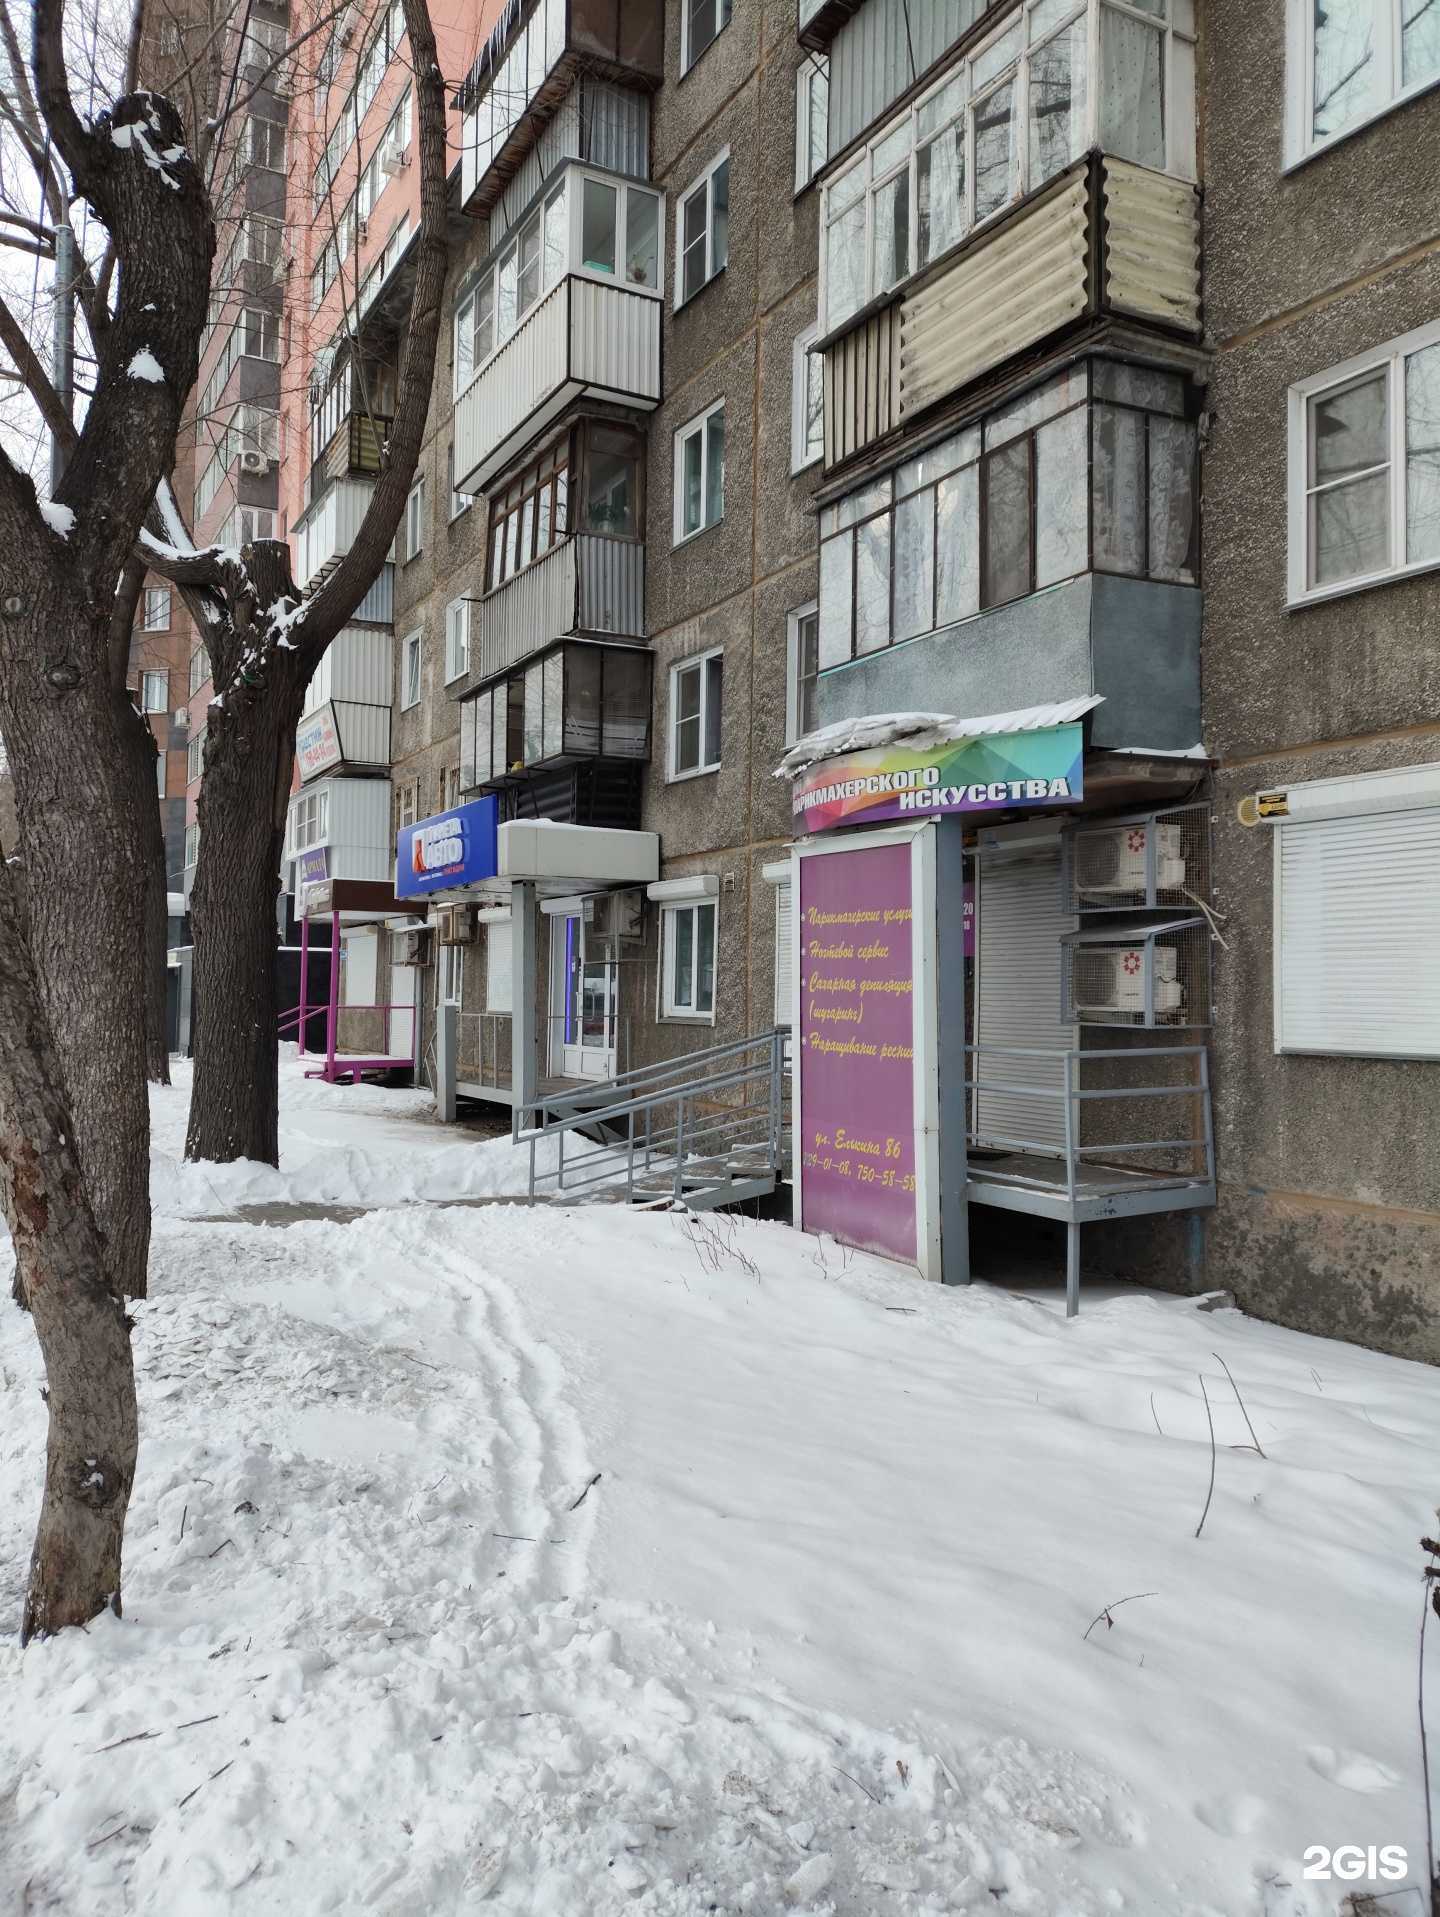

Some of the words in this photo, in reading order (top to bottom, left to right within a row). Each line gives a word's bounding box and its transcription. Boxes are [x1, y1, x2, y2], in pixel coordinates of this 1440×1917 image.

[899, 777, 1072, 810] ИСКУССТВА
[808, 906, 880, 928] Парикмахерские
[809, 941, 854, 959] Ногтевой
[857, 939, 889, 964] сервис
[809, 971, 856, 996] Сахарная
[809, 1031, 877, 1058] Наращивание
[834, 1128, 881, 1156] Елькина
[884, 1138, 901, 1160] 86
